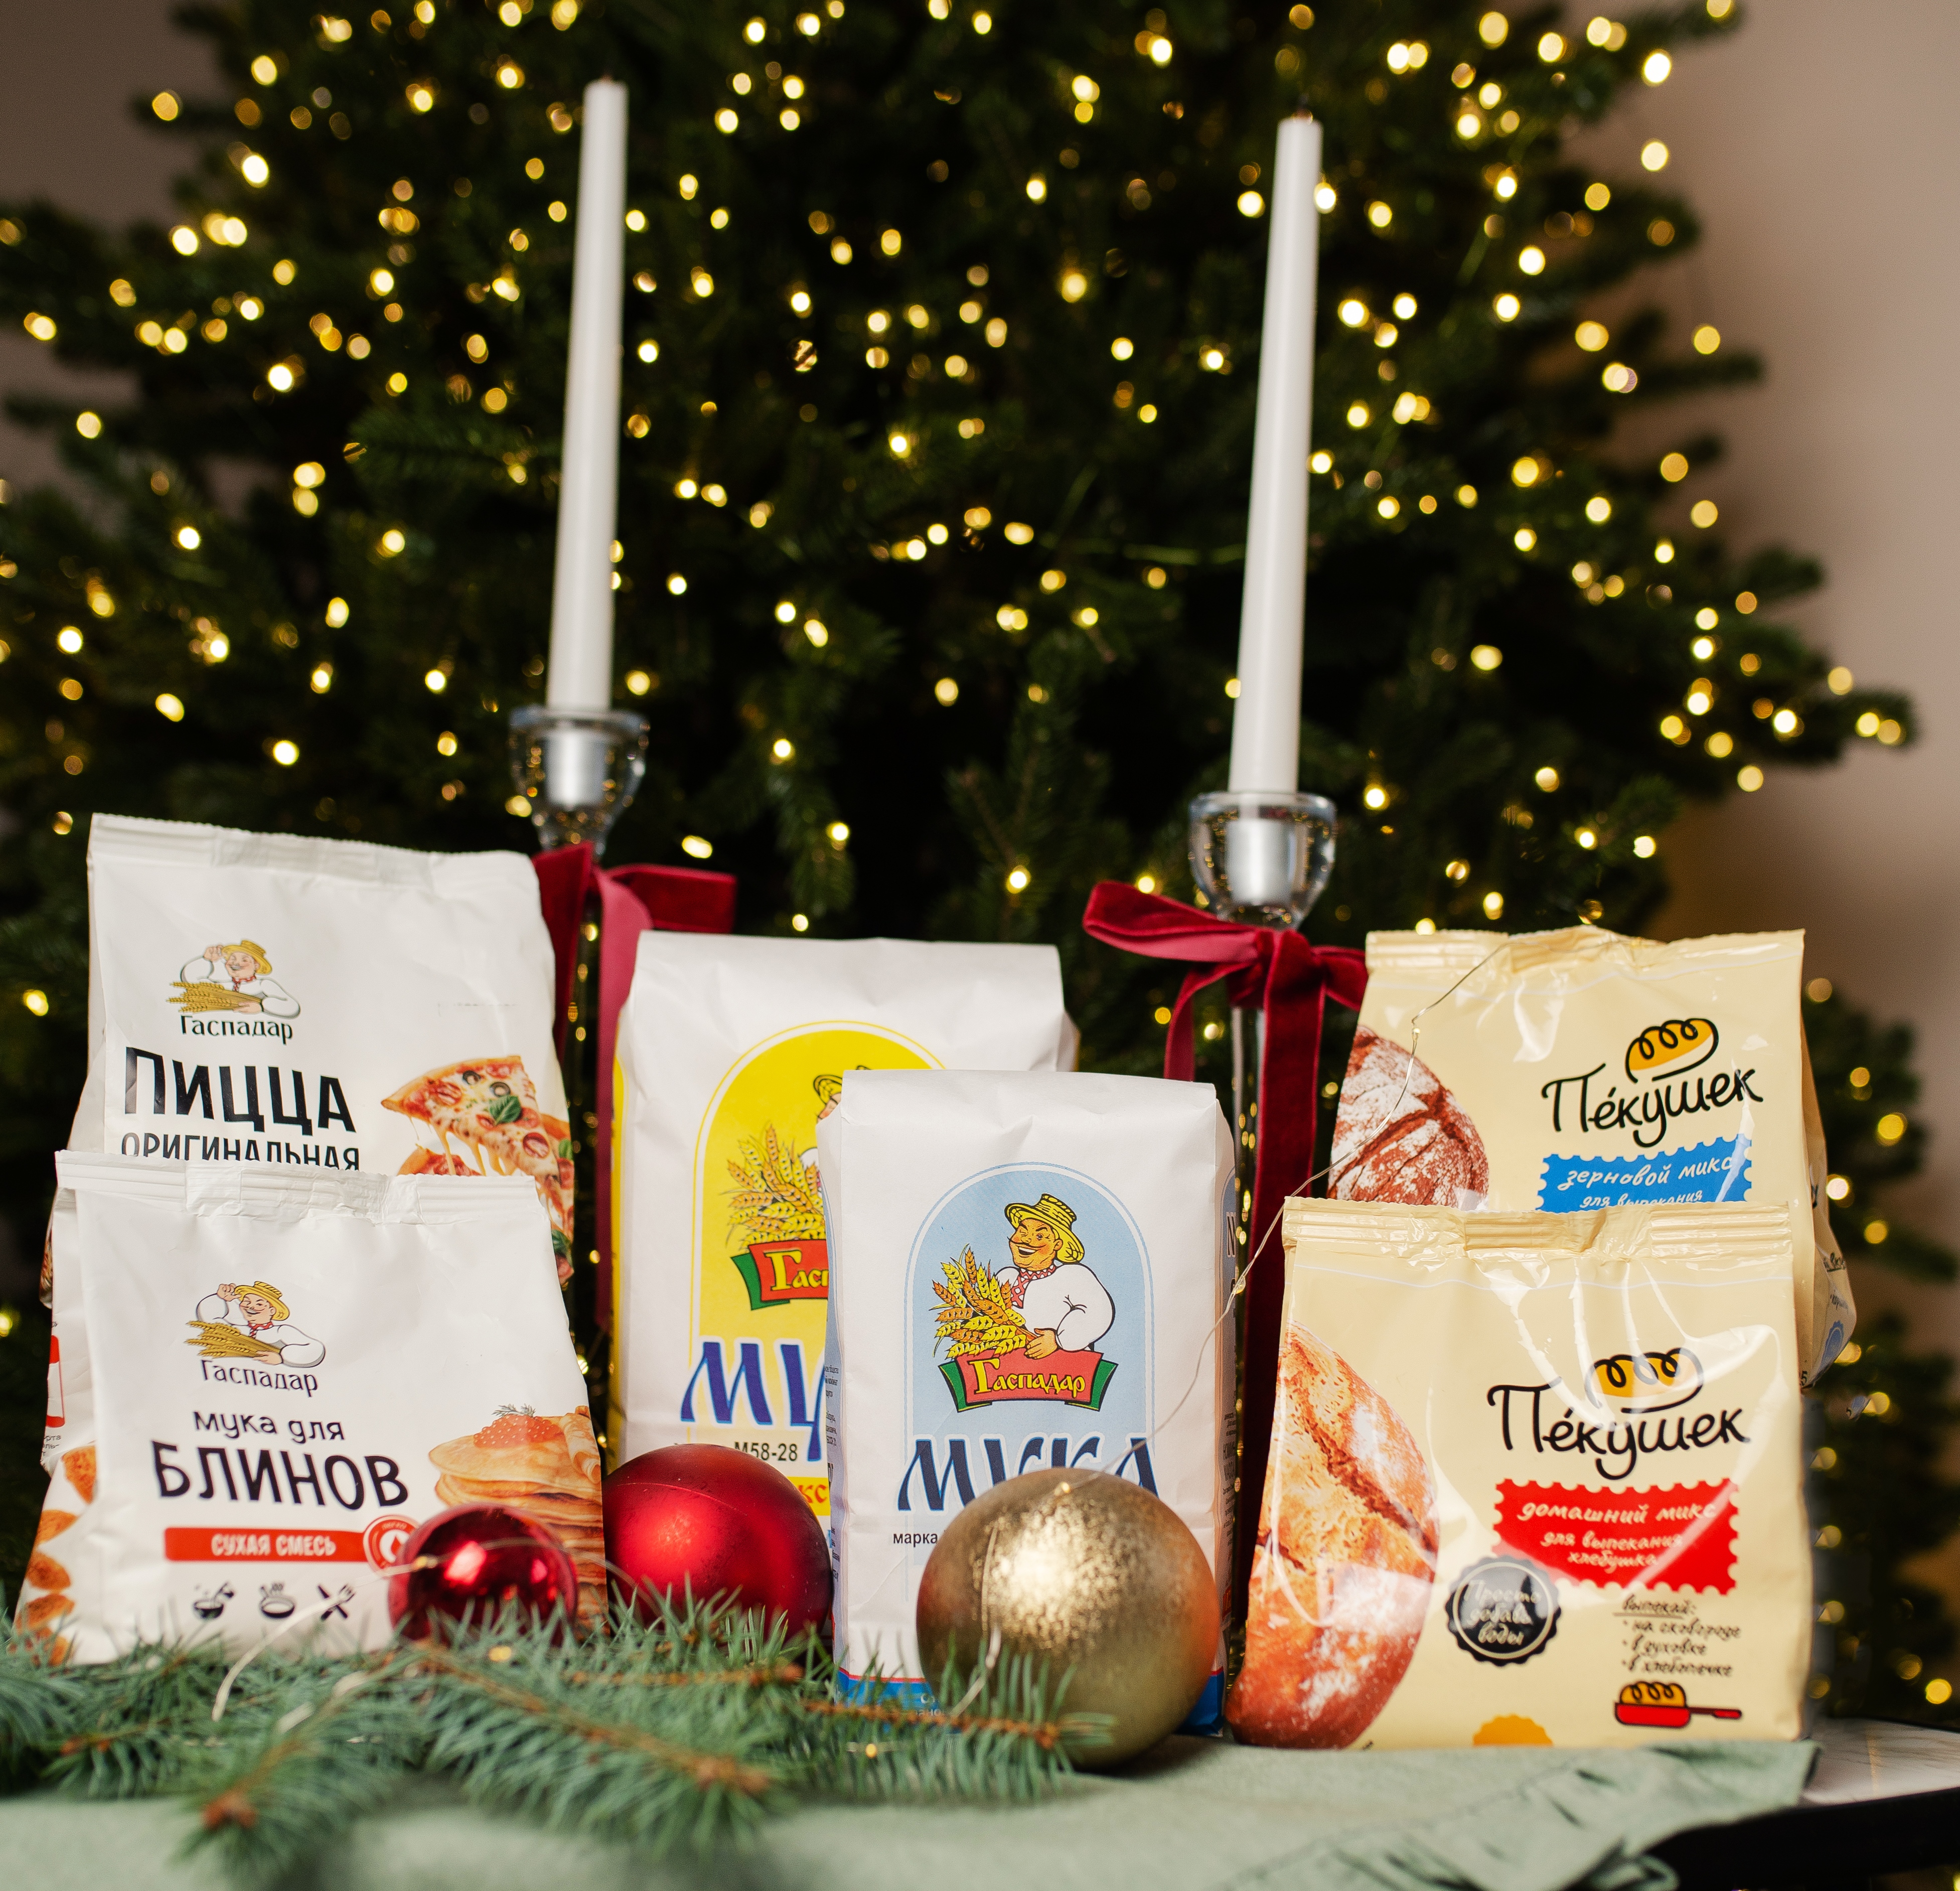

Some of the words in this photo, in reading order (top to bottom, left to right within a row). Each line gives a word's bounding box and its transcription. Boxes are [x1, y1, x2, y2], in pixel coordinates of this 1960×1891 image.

[181, 1014, 293, 1045] Гаспадар
[124, 1046, 357, 1135] ПИЦЦА
[121, 1132, 360, 1171] ОРИГИНАЛЬНАЯ
[1557, 1163, 1672, 1191] зерновой
[1678, 1156, 1733, 1180] микс
[1579, 1196, 1610, 1209] для
[201, 1360, 318, 1397] Гаспадар
[968, 1359, 1086, 1396] Гаспадар
[194, 1412, 277, 1440] мука
[289, 1417, 345, 1444] для
[151, 1440, 409, 1510] БЛИНОВ
[1517, 1502, 1649, 1524] домашний
[1655, 1503, 1716, 1522] микс
[211, 1533, 271, 1556] СУХАЯ
[275, 1534, 337, 1556] СМЕСЬ
[892, 1533, 939, 1547] марка
[1540, 1531, 1576, 1547] для
[1581, 1530, 1684, 1551] выпекания
